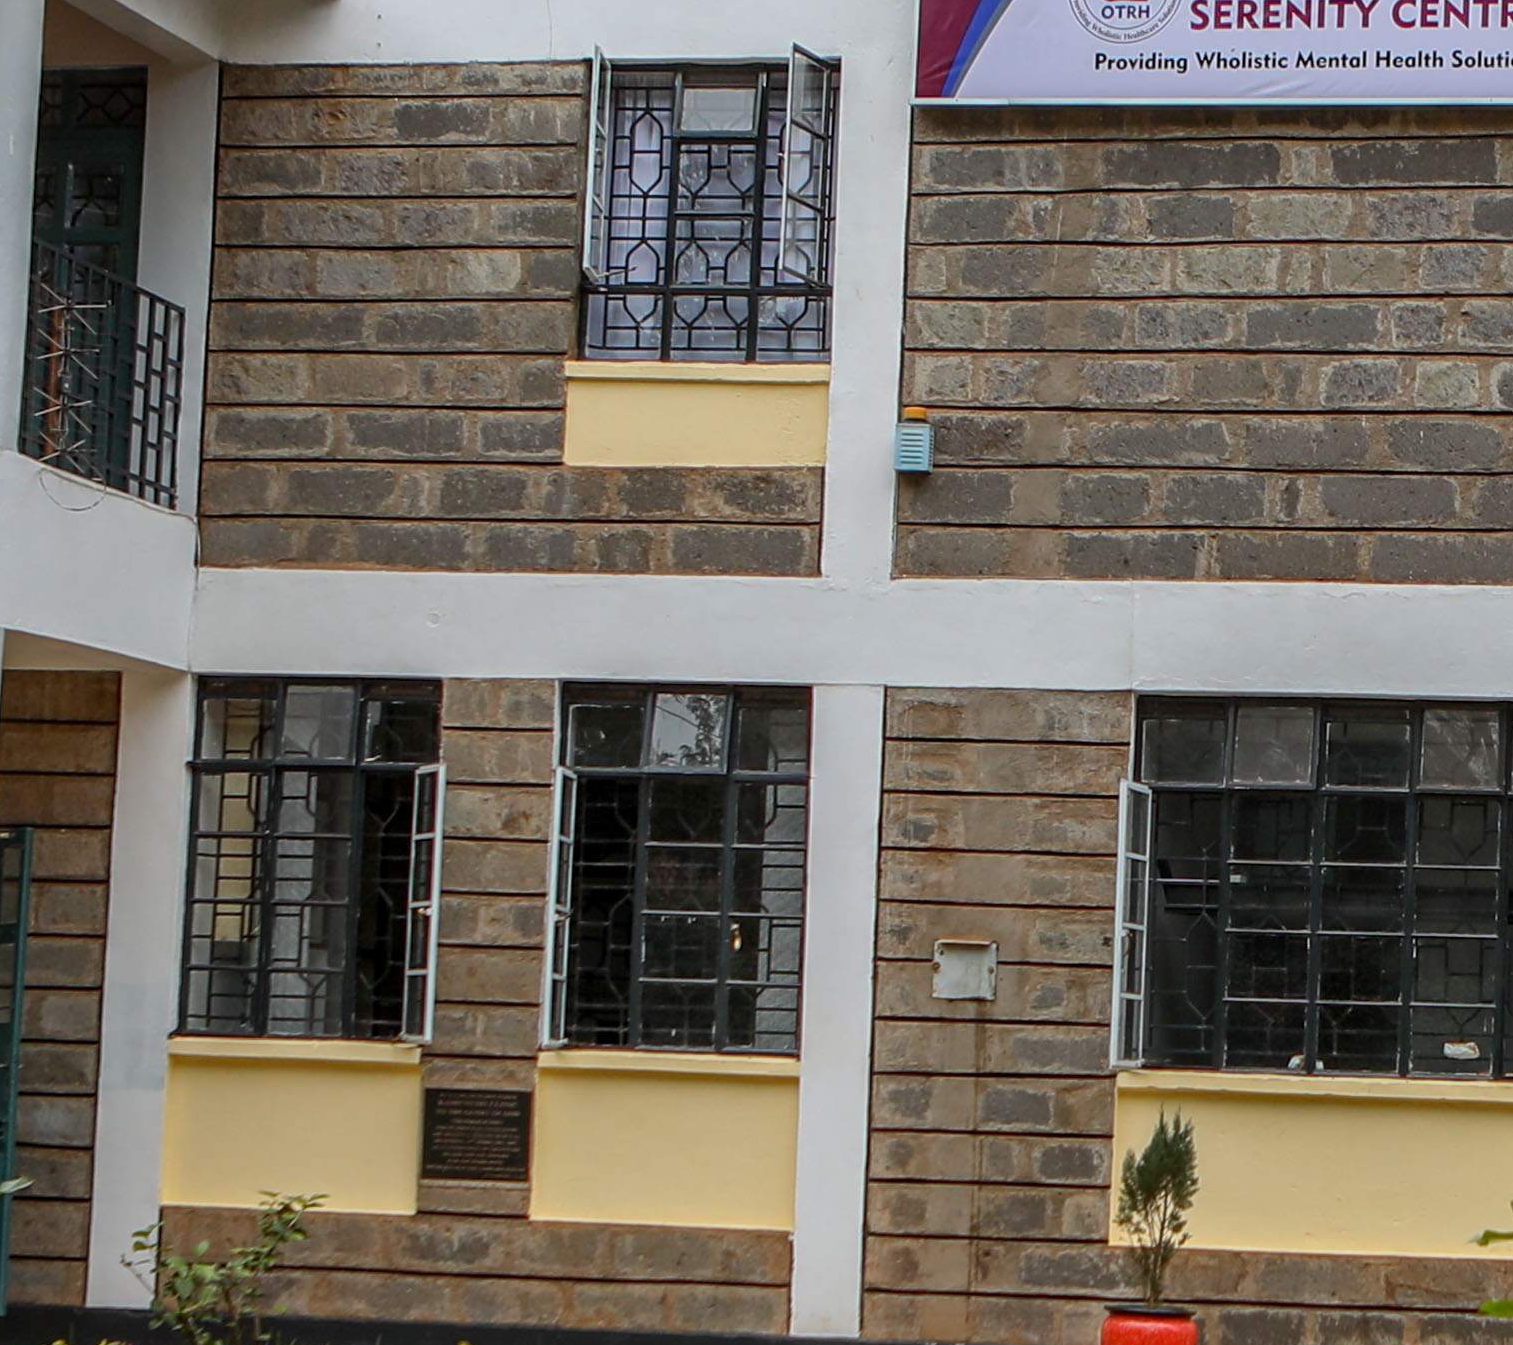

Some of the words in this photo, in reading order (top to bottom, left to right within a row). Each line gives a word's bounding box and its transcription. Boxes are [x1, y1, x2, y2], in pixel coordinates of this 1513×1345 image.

[1101, 5, 1150, 19] OTRH
[1094, 52, 1188, 73] Providing
[1195, 51, 1289, 69] Wholistic
[1295, 51, 1367, 69] Mental
[1375, 50, 1444, 68] Health
